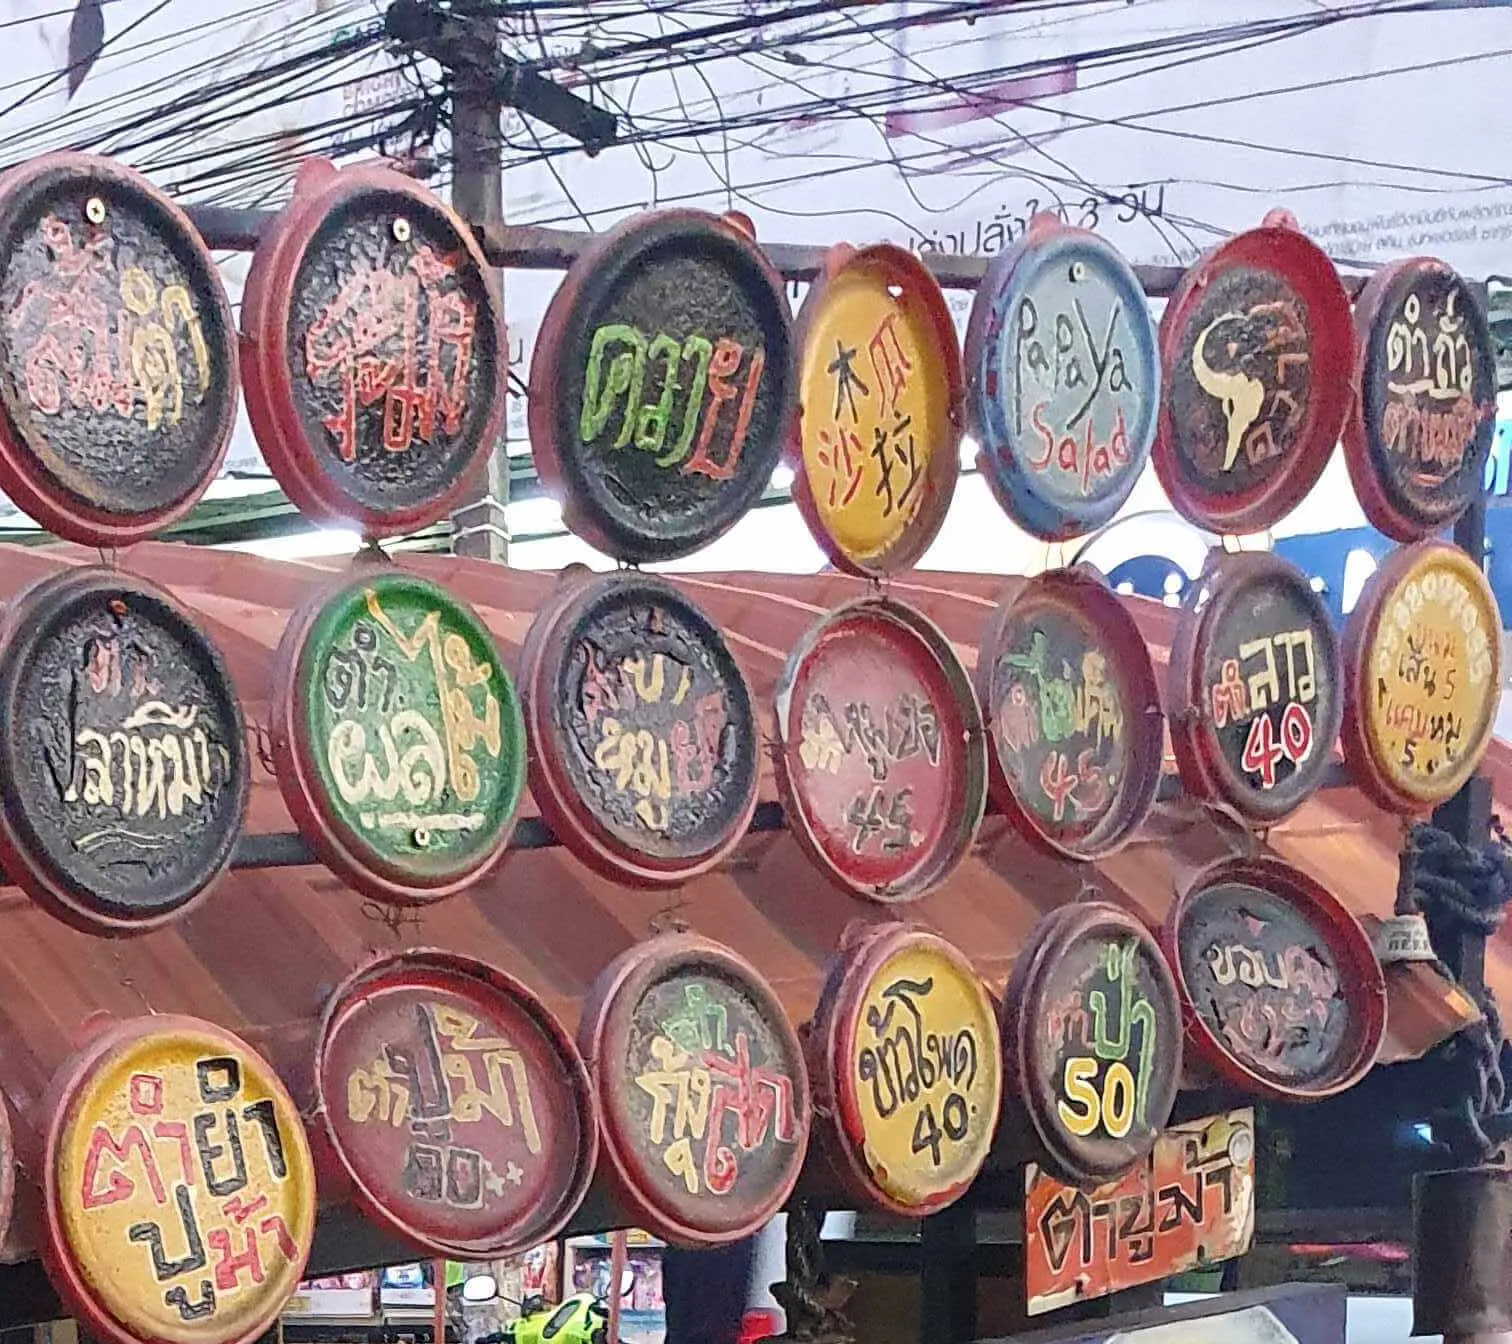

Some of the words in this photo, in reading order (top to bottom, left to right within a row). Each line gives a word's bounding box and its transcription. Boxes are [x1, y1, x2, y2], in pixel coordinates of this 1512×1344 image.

[1028, 403, 1133, 495] Salad
[1240, 702, 1313, 790] 40
[1056, 1057, 1137, 1139] 50
